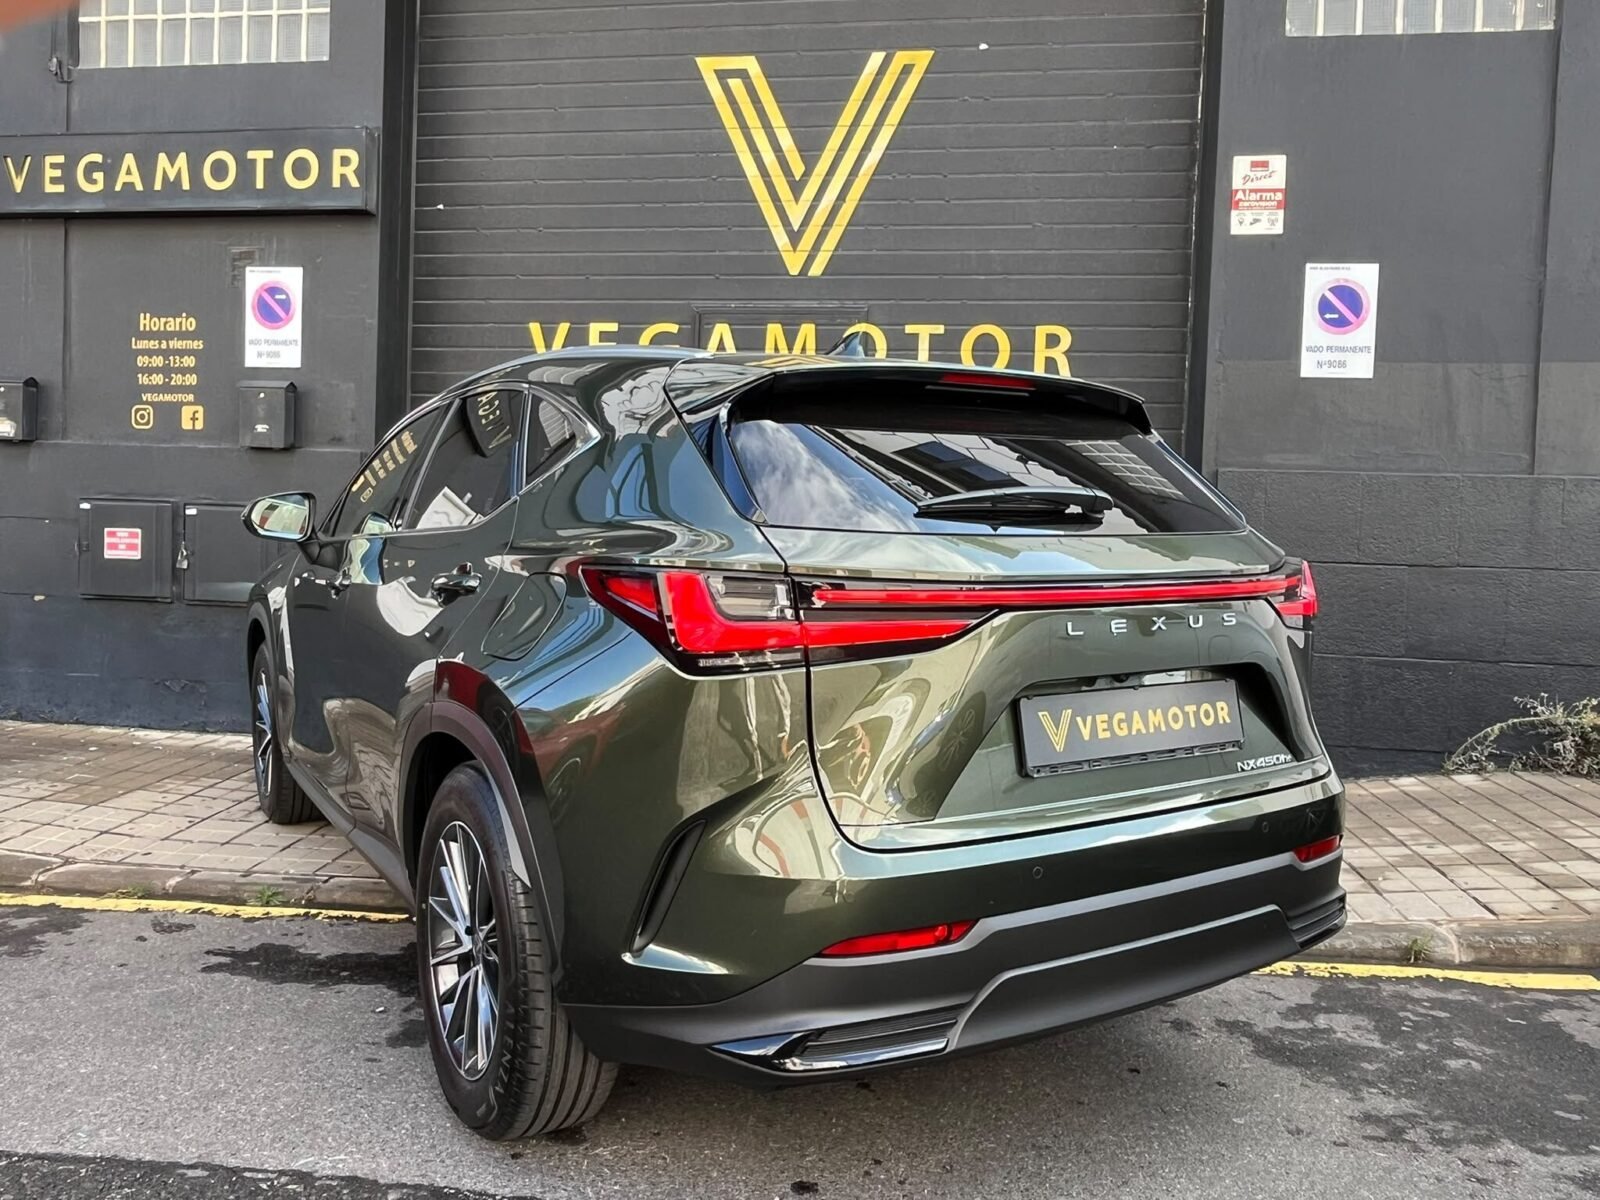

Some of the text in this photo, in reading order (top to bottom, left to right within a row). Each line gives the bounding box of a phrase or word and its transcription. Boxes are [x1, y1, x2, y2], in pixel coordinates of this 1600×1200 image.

[3, 148, 361, 193] VEGAMOTOR
[1235, 189, 1283, 201] Alarma
[140, 312, 196, 332] Horario
[131, 337, 204, 349] Lunes a viernes
[1305, 345, 1373, 354] VADO PERMANENTE
[136, 355, 163, 367] 09:00
[137, 373, 163, 385] 16:00
[170, 373, 197, 385] 20:00
[141, 393, 194, 402] VEGAMOTOR
[1066, 612, 1237, 636] LEXUS
[1076, 701, 1231, 741] VEGAMOTOR
